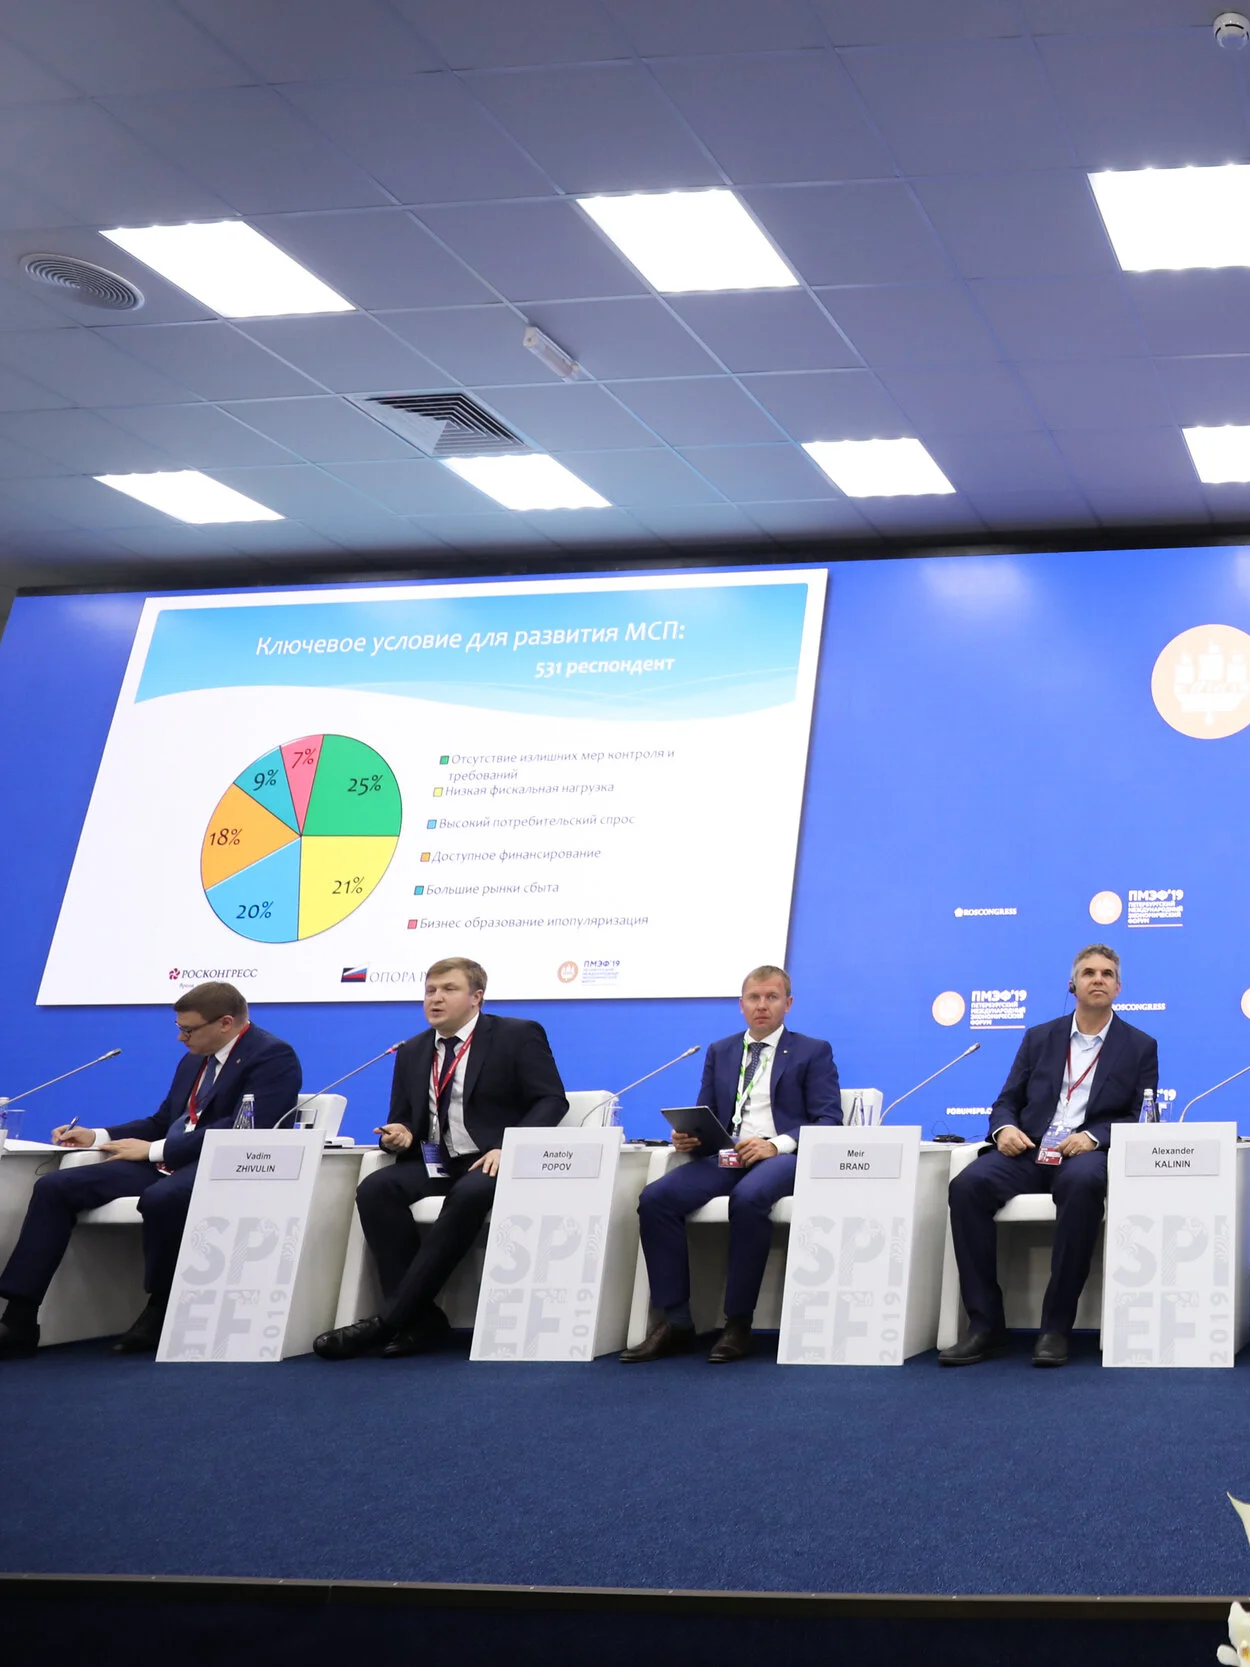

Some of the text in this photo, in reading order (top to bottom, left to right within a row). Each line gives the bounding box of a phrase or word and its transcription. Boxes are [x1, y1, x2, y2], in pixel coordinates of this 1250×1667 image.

[256, 620, 686, 656] Ключевое условие для развития МСП:
[534, 657, 675, 678] 531 респондент
[292, 748, 316, 769] 7%
[451, 750, 675, 766] Отсутствие излишних мер контроля и
[253, 769, 279, 791] 9%
[448, 769, 517, 784] требований
[347, 774, 383, 796] 25%
[445, 783, 614, 797] Низкая фискальная нагрузка
[439, 815, 635, 829] Высокий потребительский спрос
[209, 828, 243, 846] 18%
[431, 849, 601, 864] Доступное финансирование
[332, 876, 365, 895] 21%
[426, 882, 559, 896] Большие рынки сбыта
[236, 901, 274, 919] 20%
[963, 907, 1017, 916] ROSCONGRESS
[420, 915, 648, 929] Бизнес образование ипопуляризация
[181, 968, 258, 979] РОСКОНГРЕСС
[369, 971, 416, 983] ОПОРА
[946, 1107, 993, 1115] FORUMSPB.C
[246, 1151, 272, 1161] Vadim
[542, 1149, 574, 1161] Anatoly
[847, 1149, 865, 1159] Meir
[1151, 1146, 1195, 1156] Alexander
[236, 1163, 276, 1174] ZHIVULIN
[542, 1162, 572, 1172] POPOV
[839, 1162, 871, 1172] BRAND
[1154, 1159, 1192, 1169] KALININ
[258, 1289, 288, 1358] 2019
[568, 1289, 596, 1358] 2019
[879, 1292, 904, 1363] 2019
[1209, 1292, 1229, 1364] 2019
